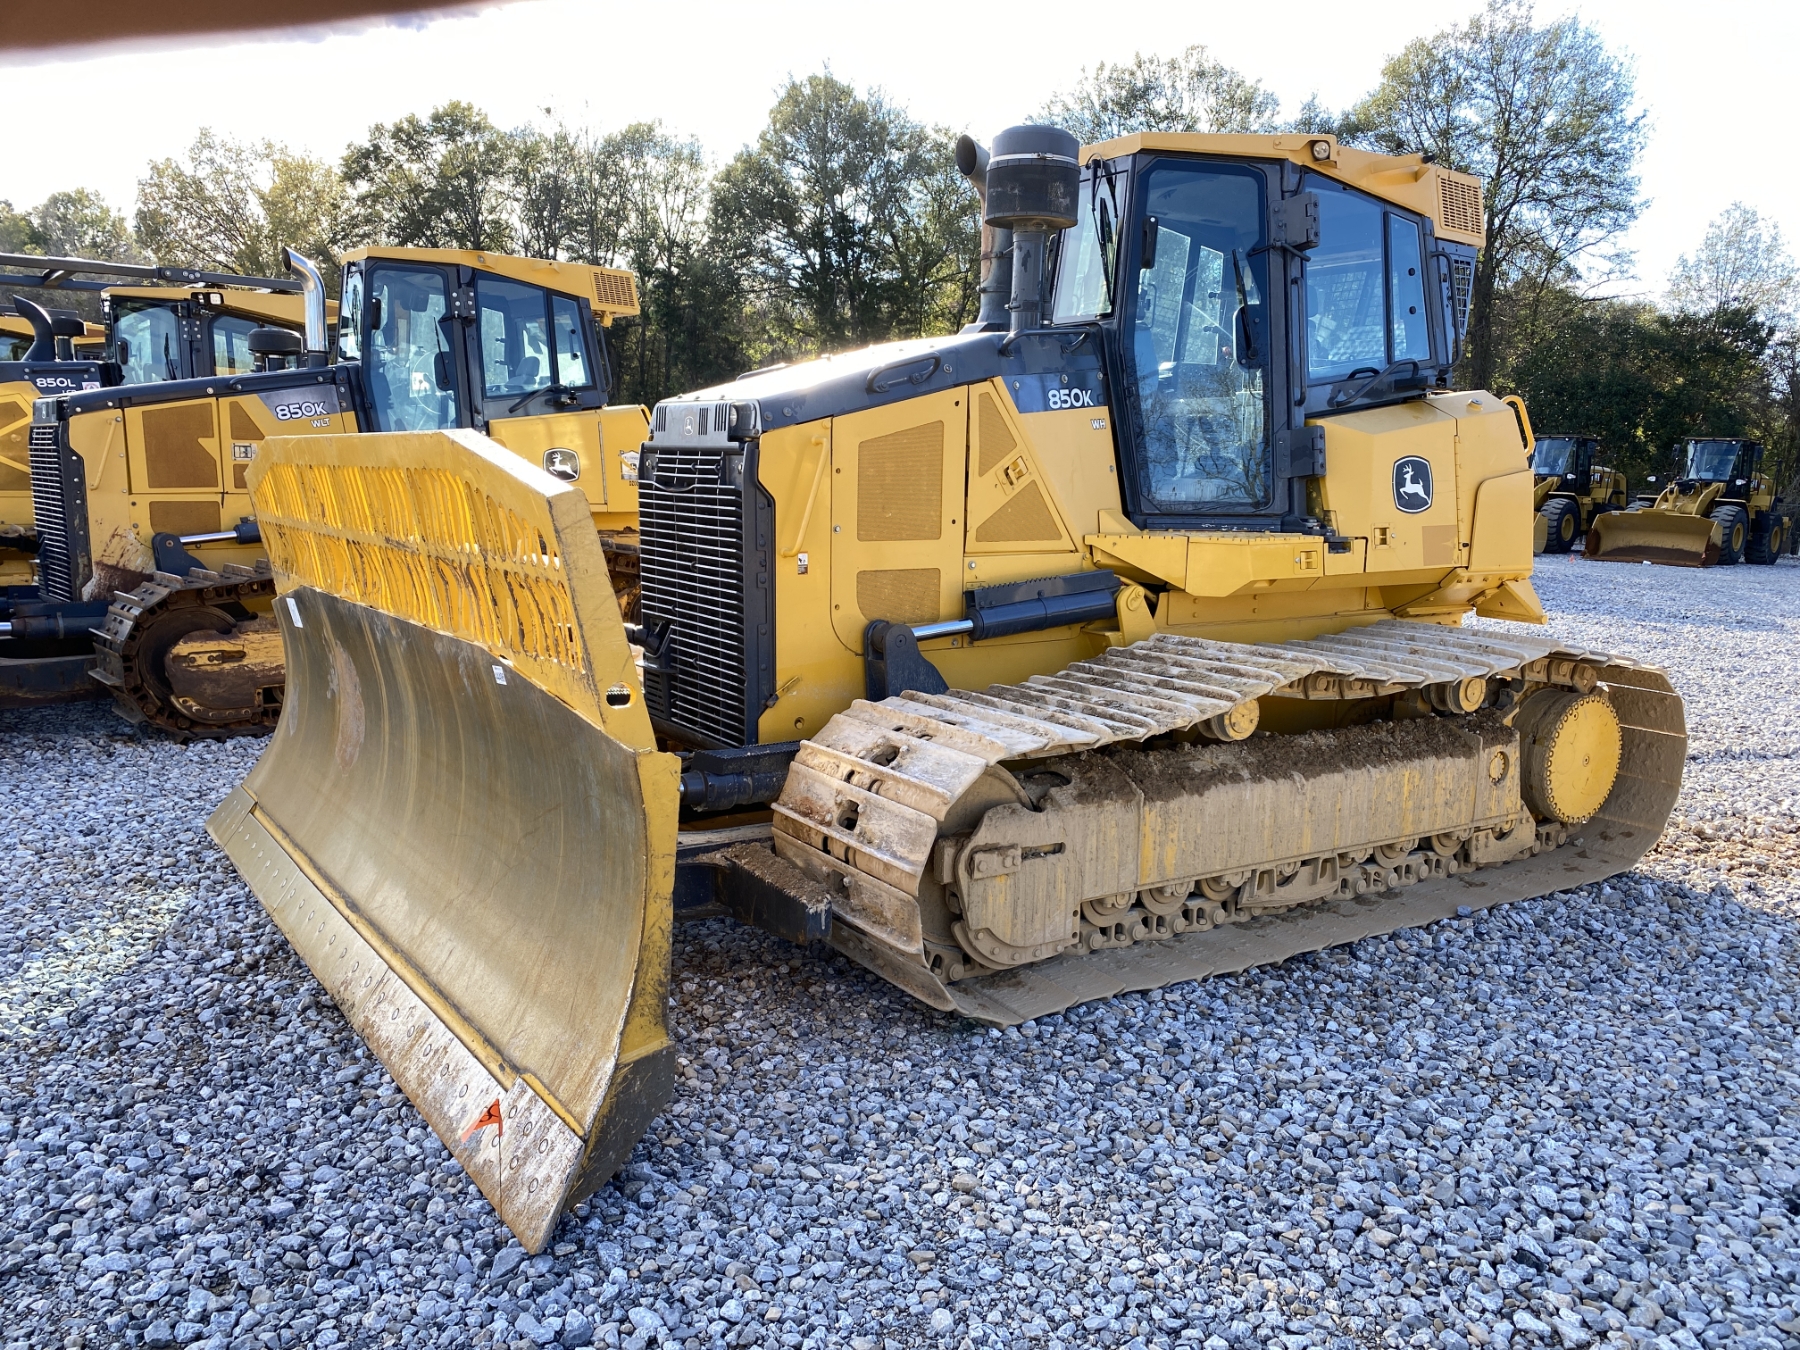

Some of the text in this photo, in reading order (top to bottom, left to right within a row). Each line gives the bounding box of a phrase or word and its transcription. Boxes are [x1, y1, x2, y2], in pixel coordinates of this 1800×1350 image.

[36, 378, 76, 387] 850L
[1047, 388, 1095, 409] 850K
[276, 402, 328, 420] 850K
[310, 418, 330, 428] WLT
[1090, 419, 1106, 430] WH
